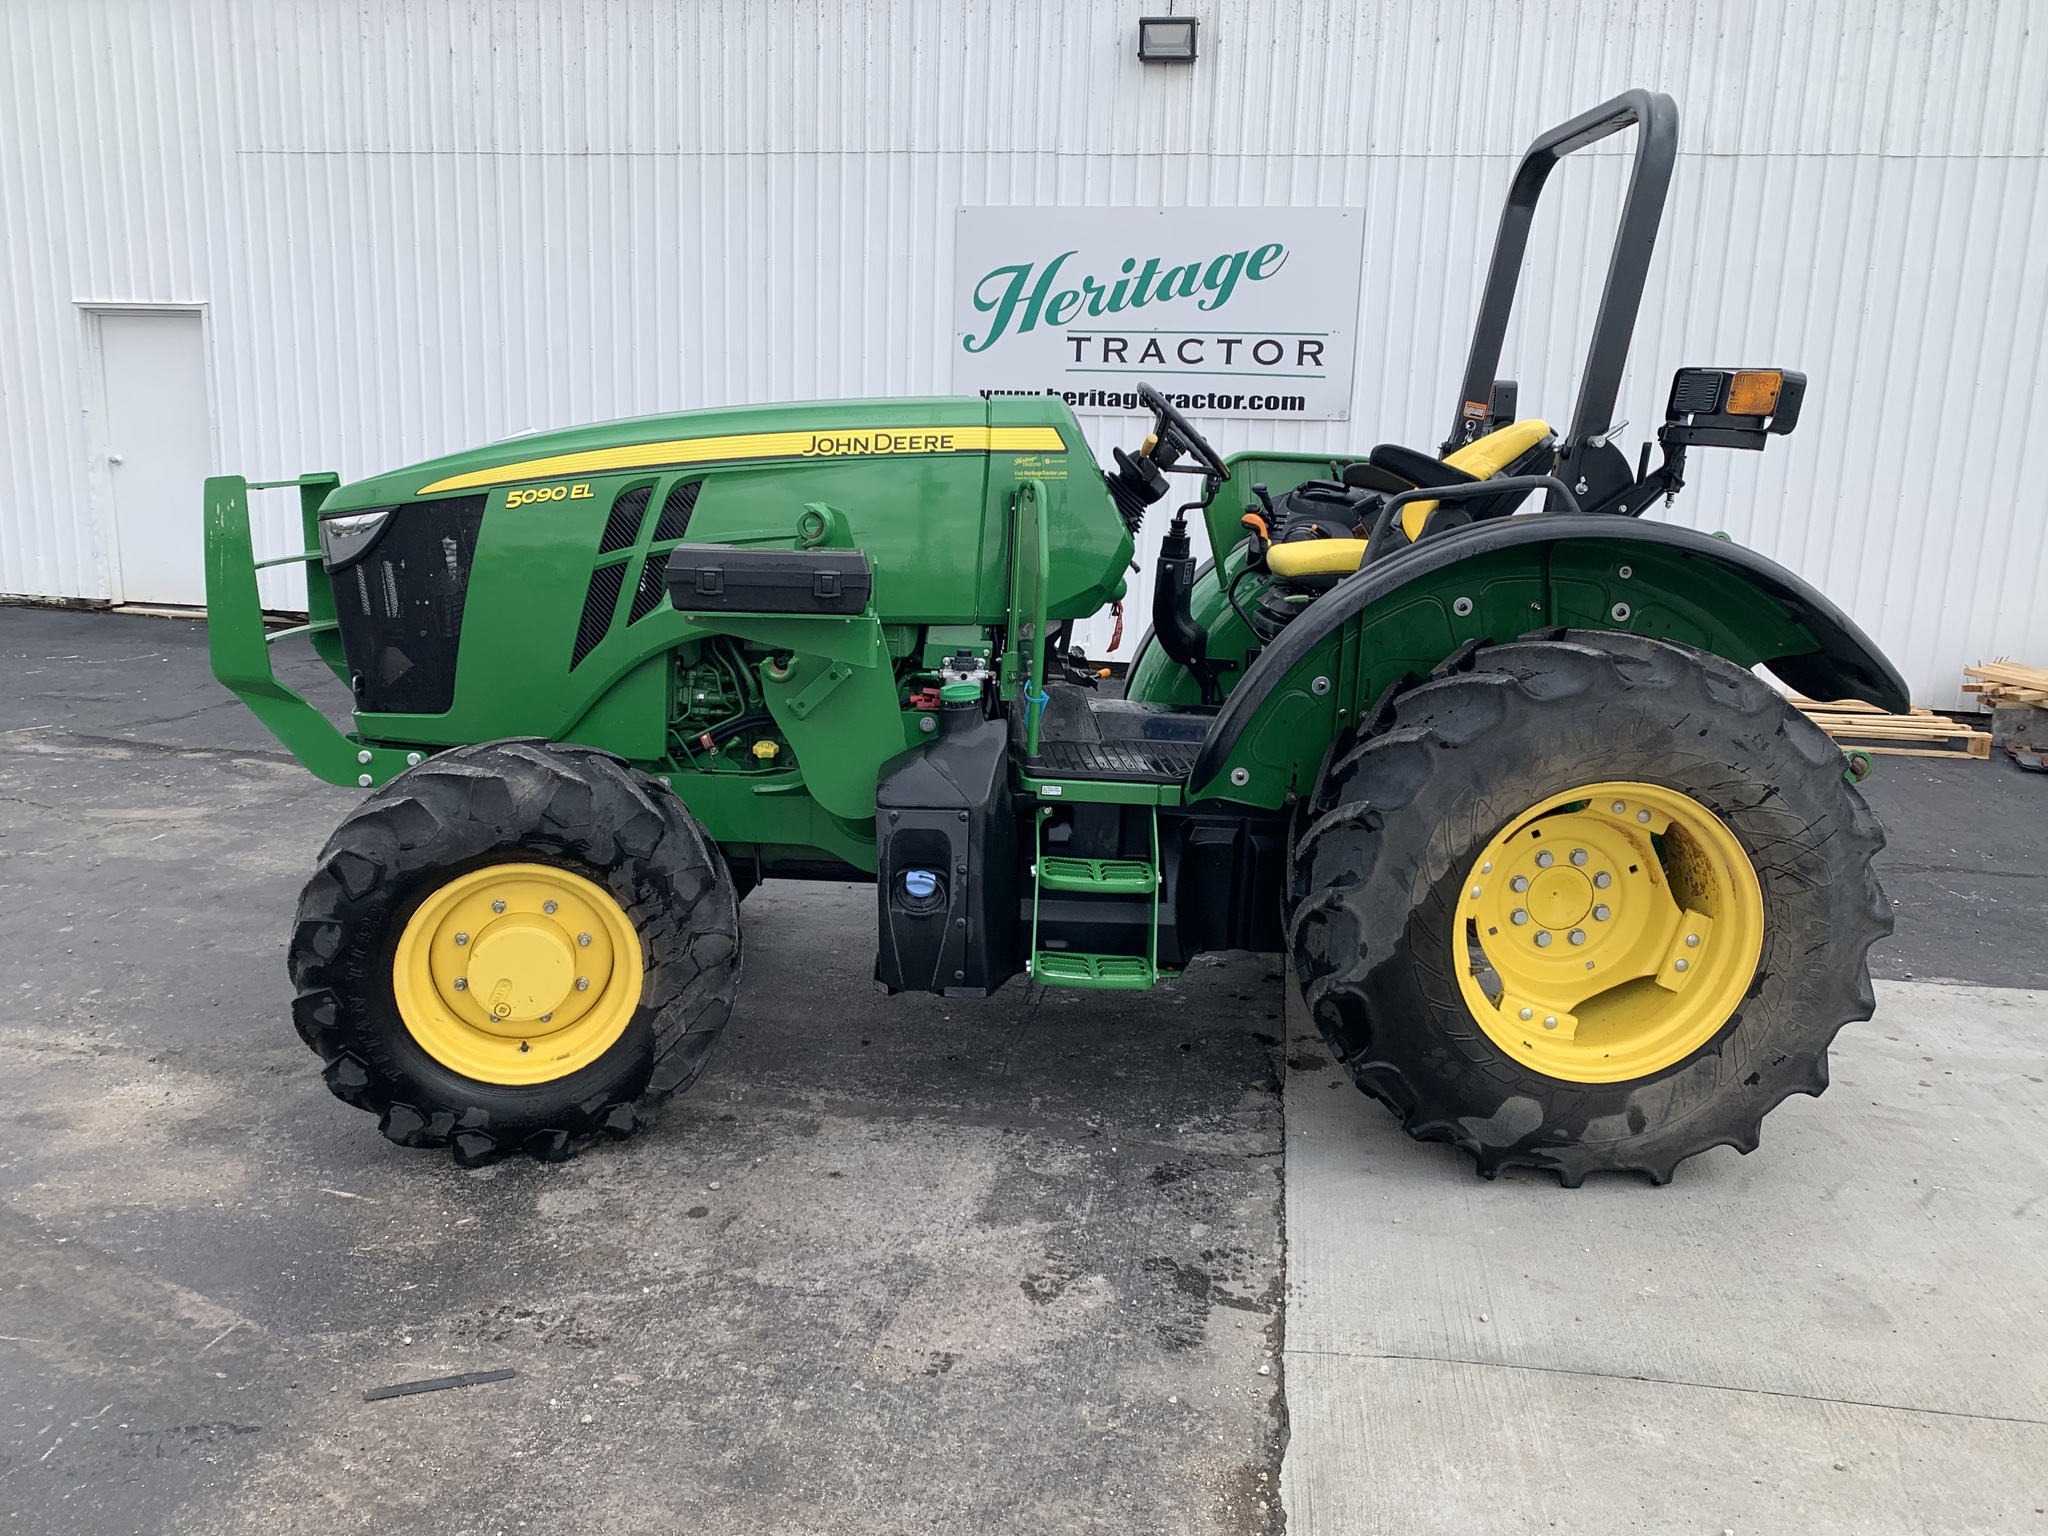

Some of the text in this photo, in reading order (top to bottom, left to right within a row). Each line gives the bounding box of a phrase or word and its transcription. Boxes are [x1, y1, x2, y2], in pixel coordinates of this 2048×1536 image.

[962, 243, 1290, 353] Heritage
[1067, 335, 1325, 367] TRACTOR
[802, 433, 955, 454] JOHN DEERE
[505, 483, 596, 509] 5090 EL
